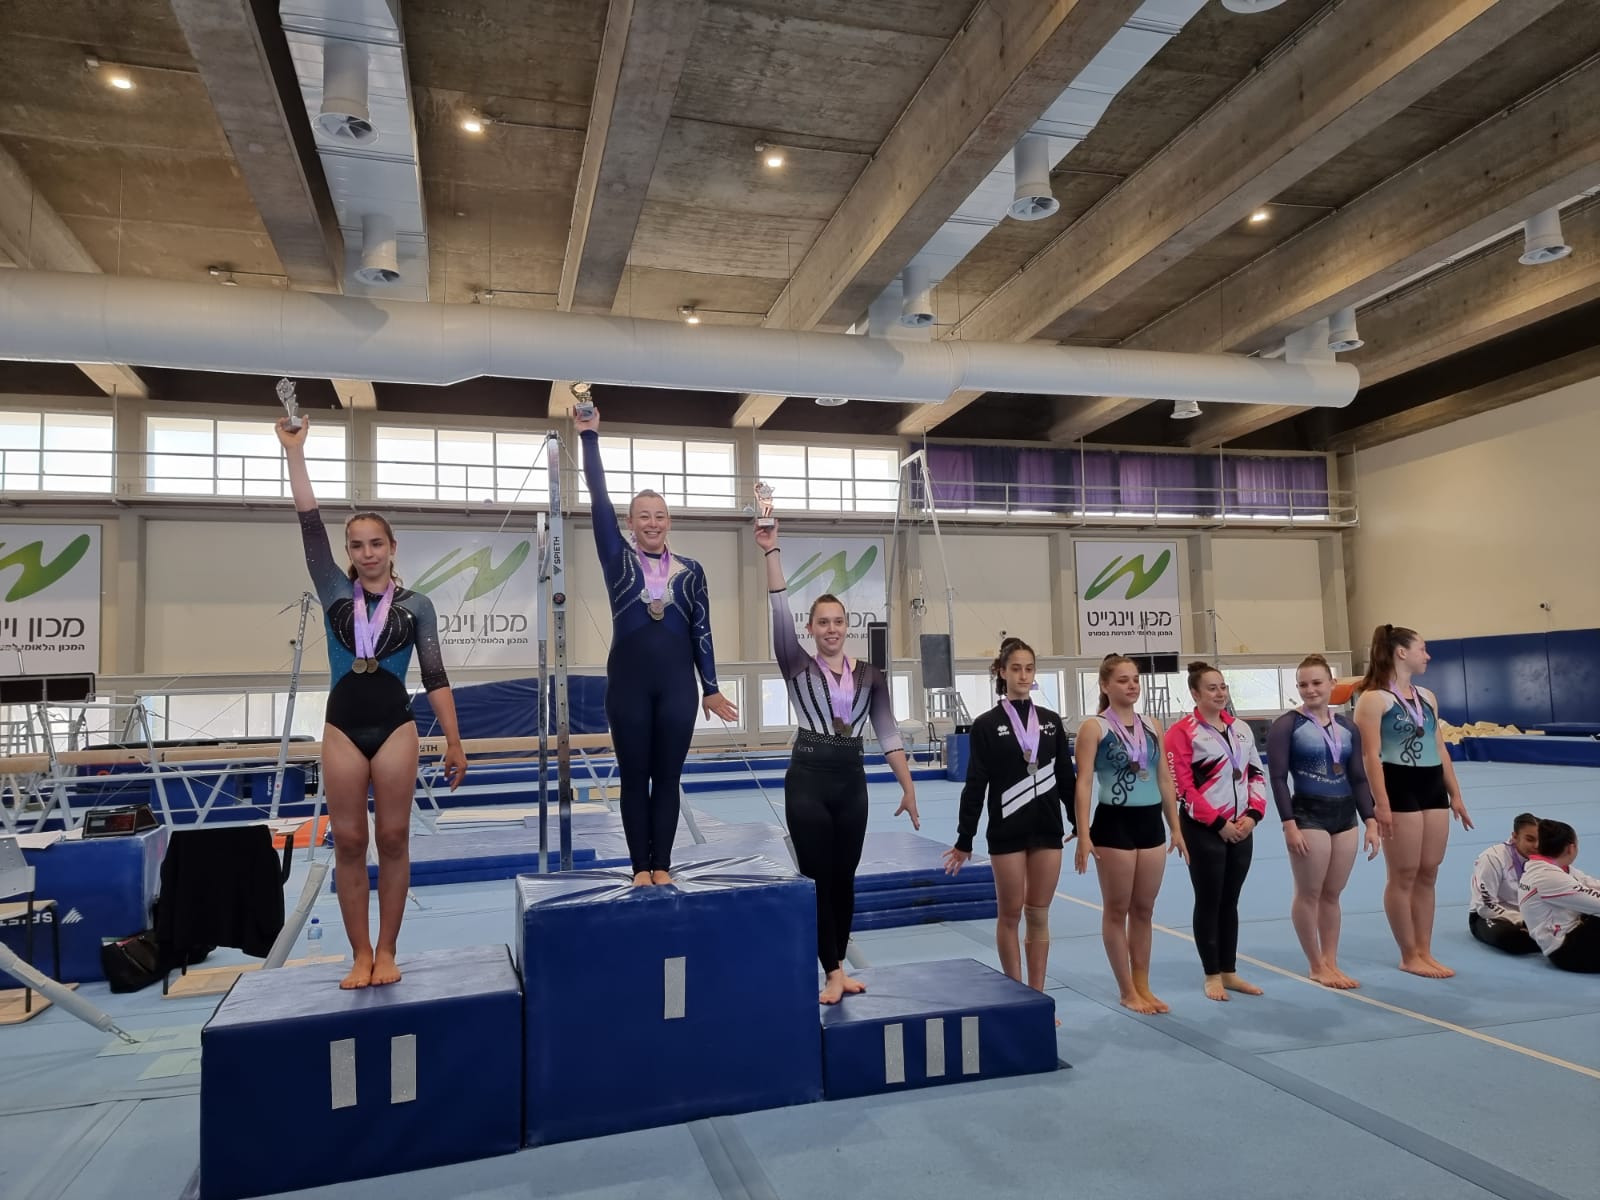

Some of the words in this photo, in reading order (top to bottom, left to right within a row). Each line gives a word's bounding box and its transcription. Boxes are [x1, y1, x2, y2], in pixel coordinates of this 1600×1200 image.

[552, 536, 562, 565] SPIETH
[439, 614, 475, 633] וינג
[483, 614, 528, 636] מכון
[846, 612, 877, 628] מכו
[1087, 611, 1134, 626] וינגייט
[1140, 611, 1172, 630] מכון
[29, 617, 85, 642] מכון
[21, 643, 56, 651] הלאומי
[59, 643, 85, 652] המכון
[506, 637, 529, 646] המכון
